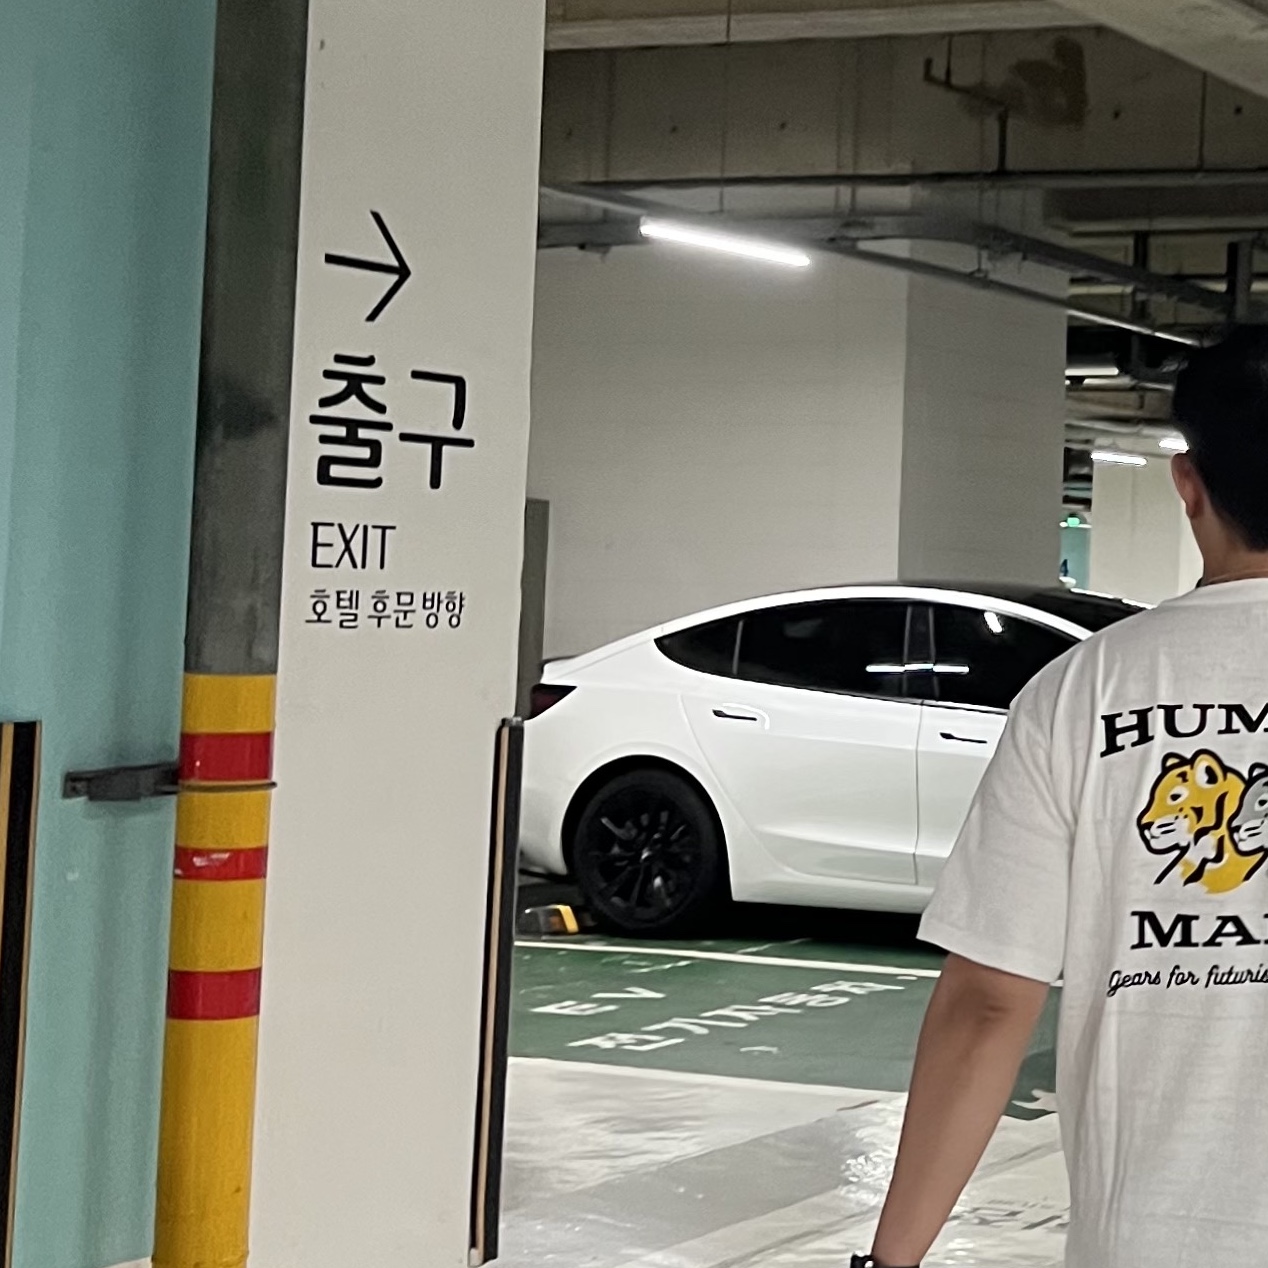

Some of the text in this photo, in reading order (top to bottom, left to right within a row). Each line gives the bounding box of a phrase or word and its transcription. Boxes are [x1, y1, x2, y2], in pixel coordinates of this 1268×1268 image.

[308, 353, 475, 490] 출구
[310, 521, 397, 571] EXIT
[304, 588, 466, 630] 호텔 후문 방향
[1166, 964, 1200, 989] for
